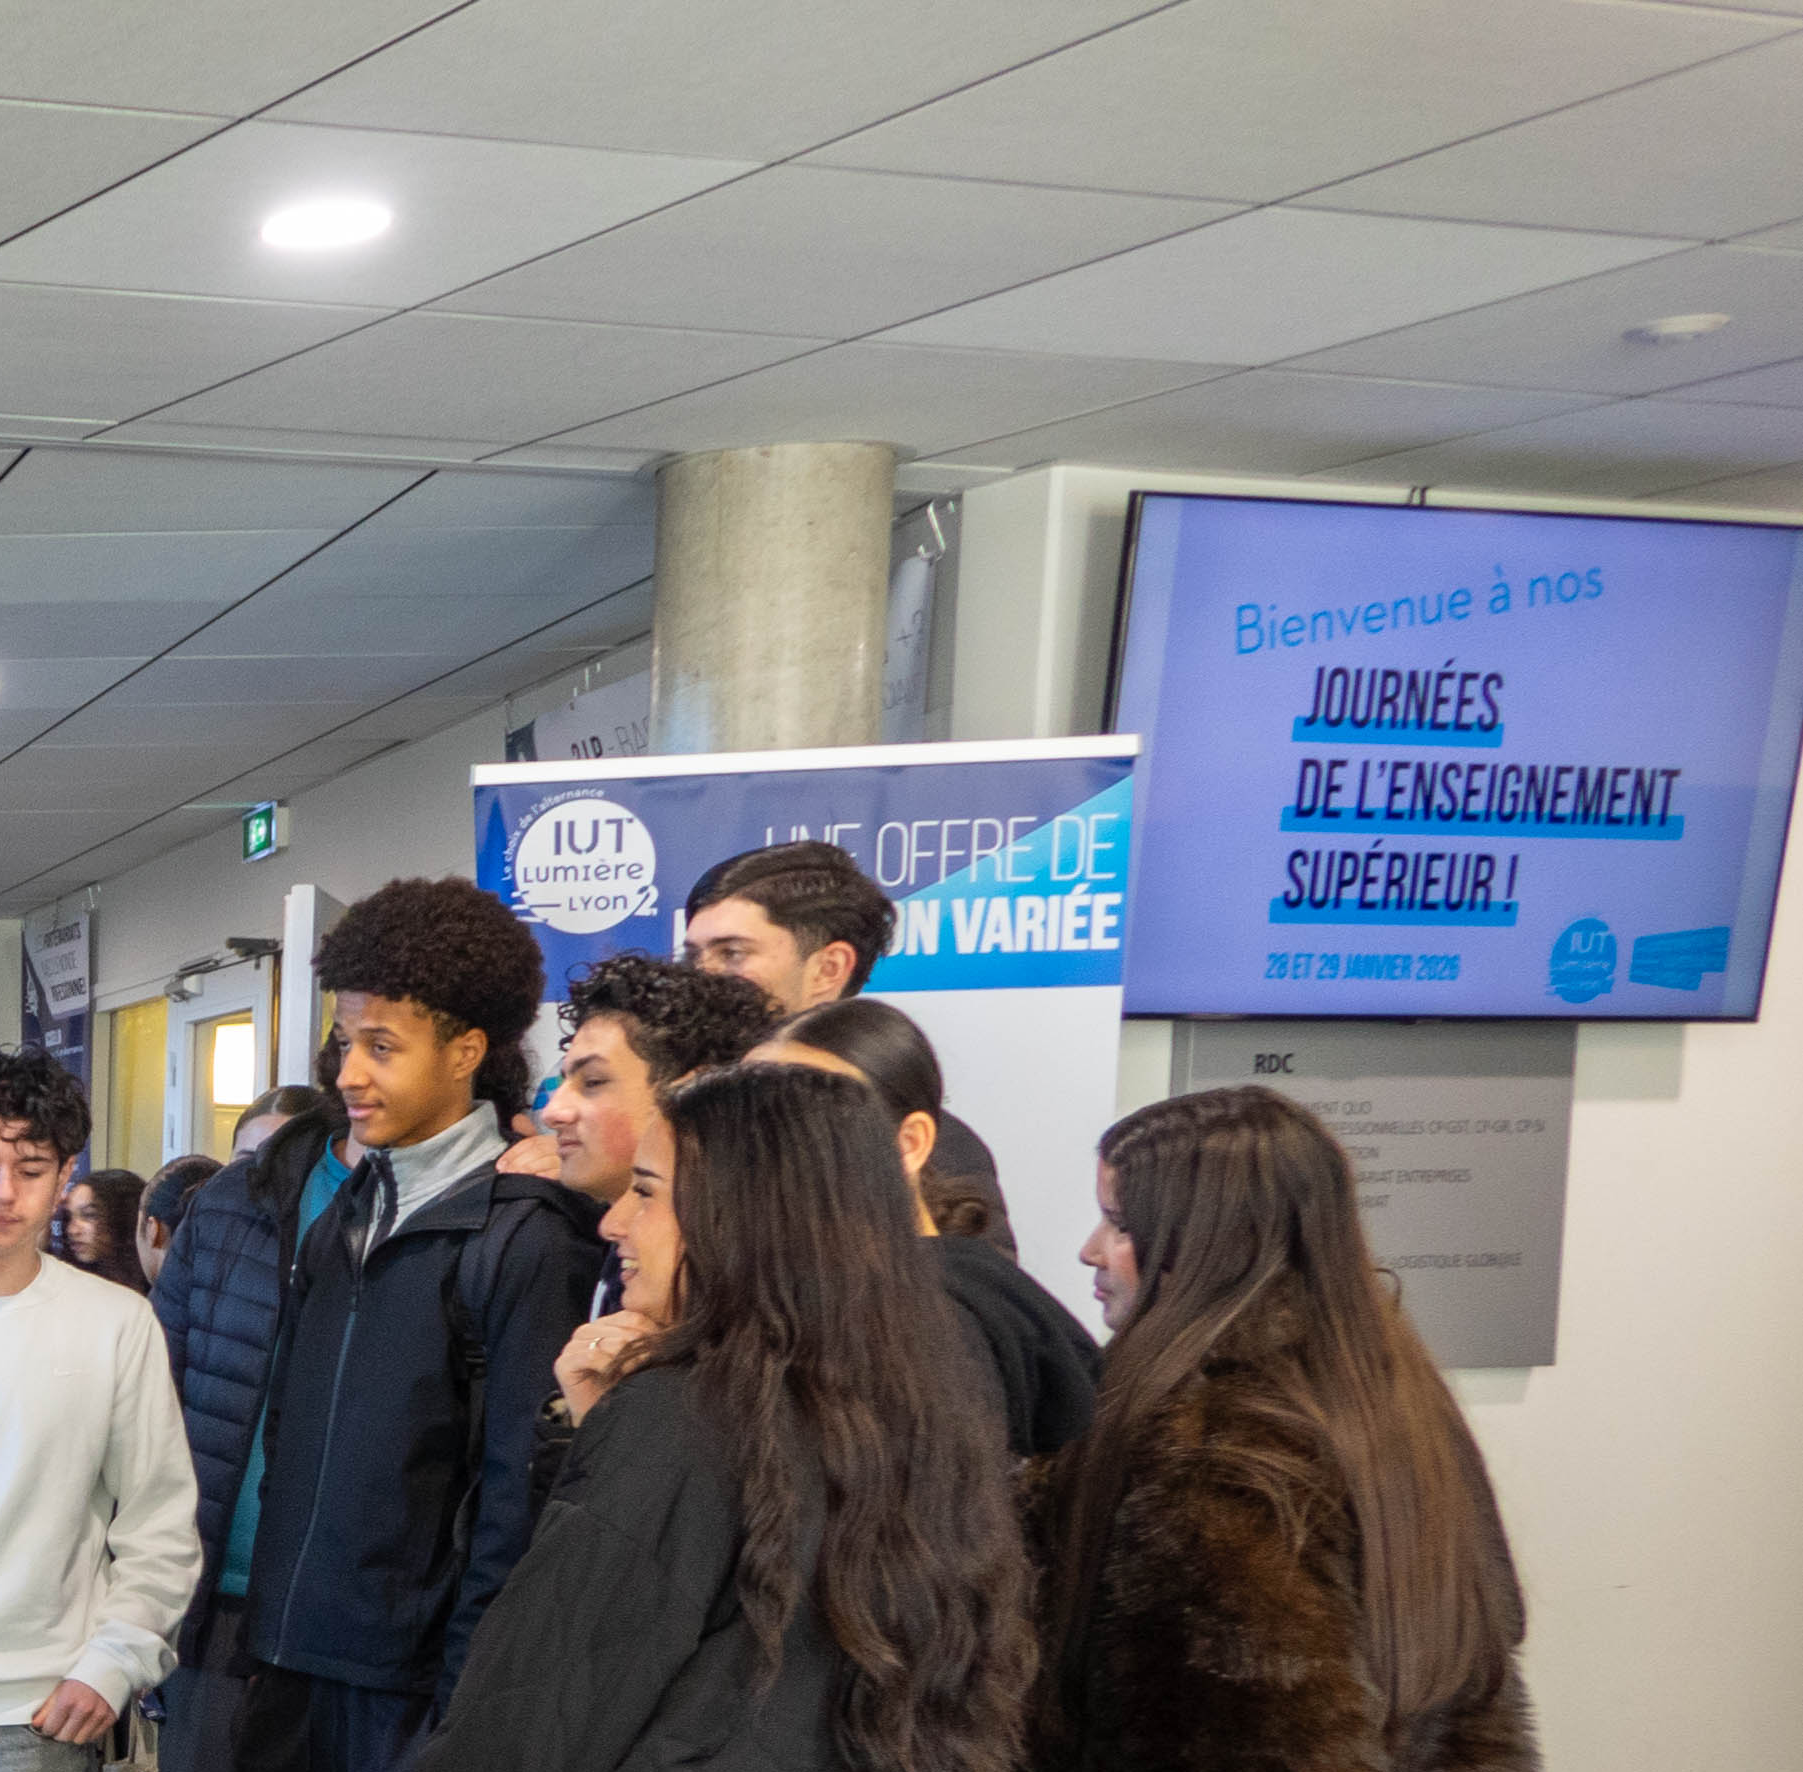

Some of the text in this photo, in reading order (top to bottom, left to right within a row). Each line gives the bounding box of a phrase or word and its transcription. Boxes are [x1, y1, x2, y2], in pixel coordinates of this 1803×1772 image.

[1235, 565, 1604, 655] Bienvenue à nos
[1305, 658, 1504, 733] JOURNÉES
[1295, 758, 1681, 827] DE L'ENSEIGNEMENT
[554, 818, 634, 855] IUT
[876, 816, 1037, 887] OFFRE
[1053, 813, 1119, 882] DE
[523, 859, 644, 883] Lumière
[1283, 839, 1519, 913] SUPÉRIEUR !
[569, 884, 659, 916] Lyon 2
[953, 884, 1121, 954] VARIÉE
[1293, 953, 1314, 979] ET
[1318, 953, 1341, 979] 29
[1344, 953, 1413, 980] JANVIER
[1416, 954, 1461, 981] 2026
[1569, 931, 1609, 953] IUT
[1254, 1053, 1293, 1074] RDC
